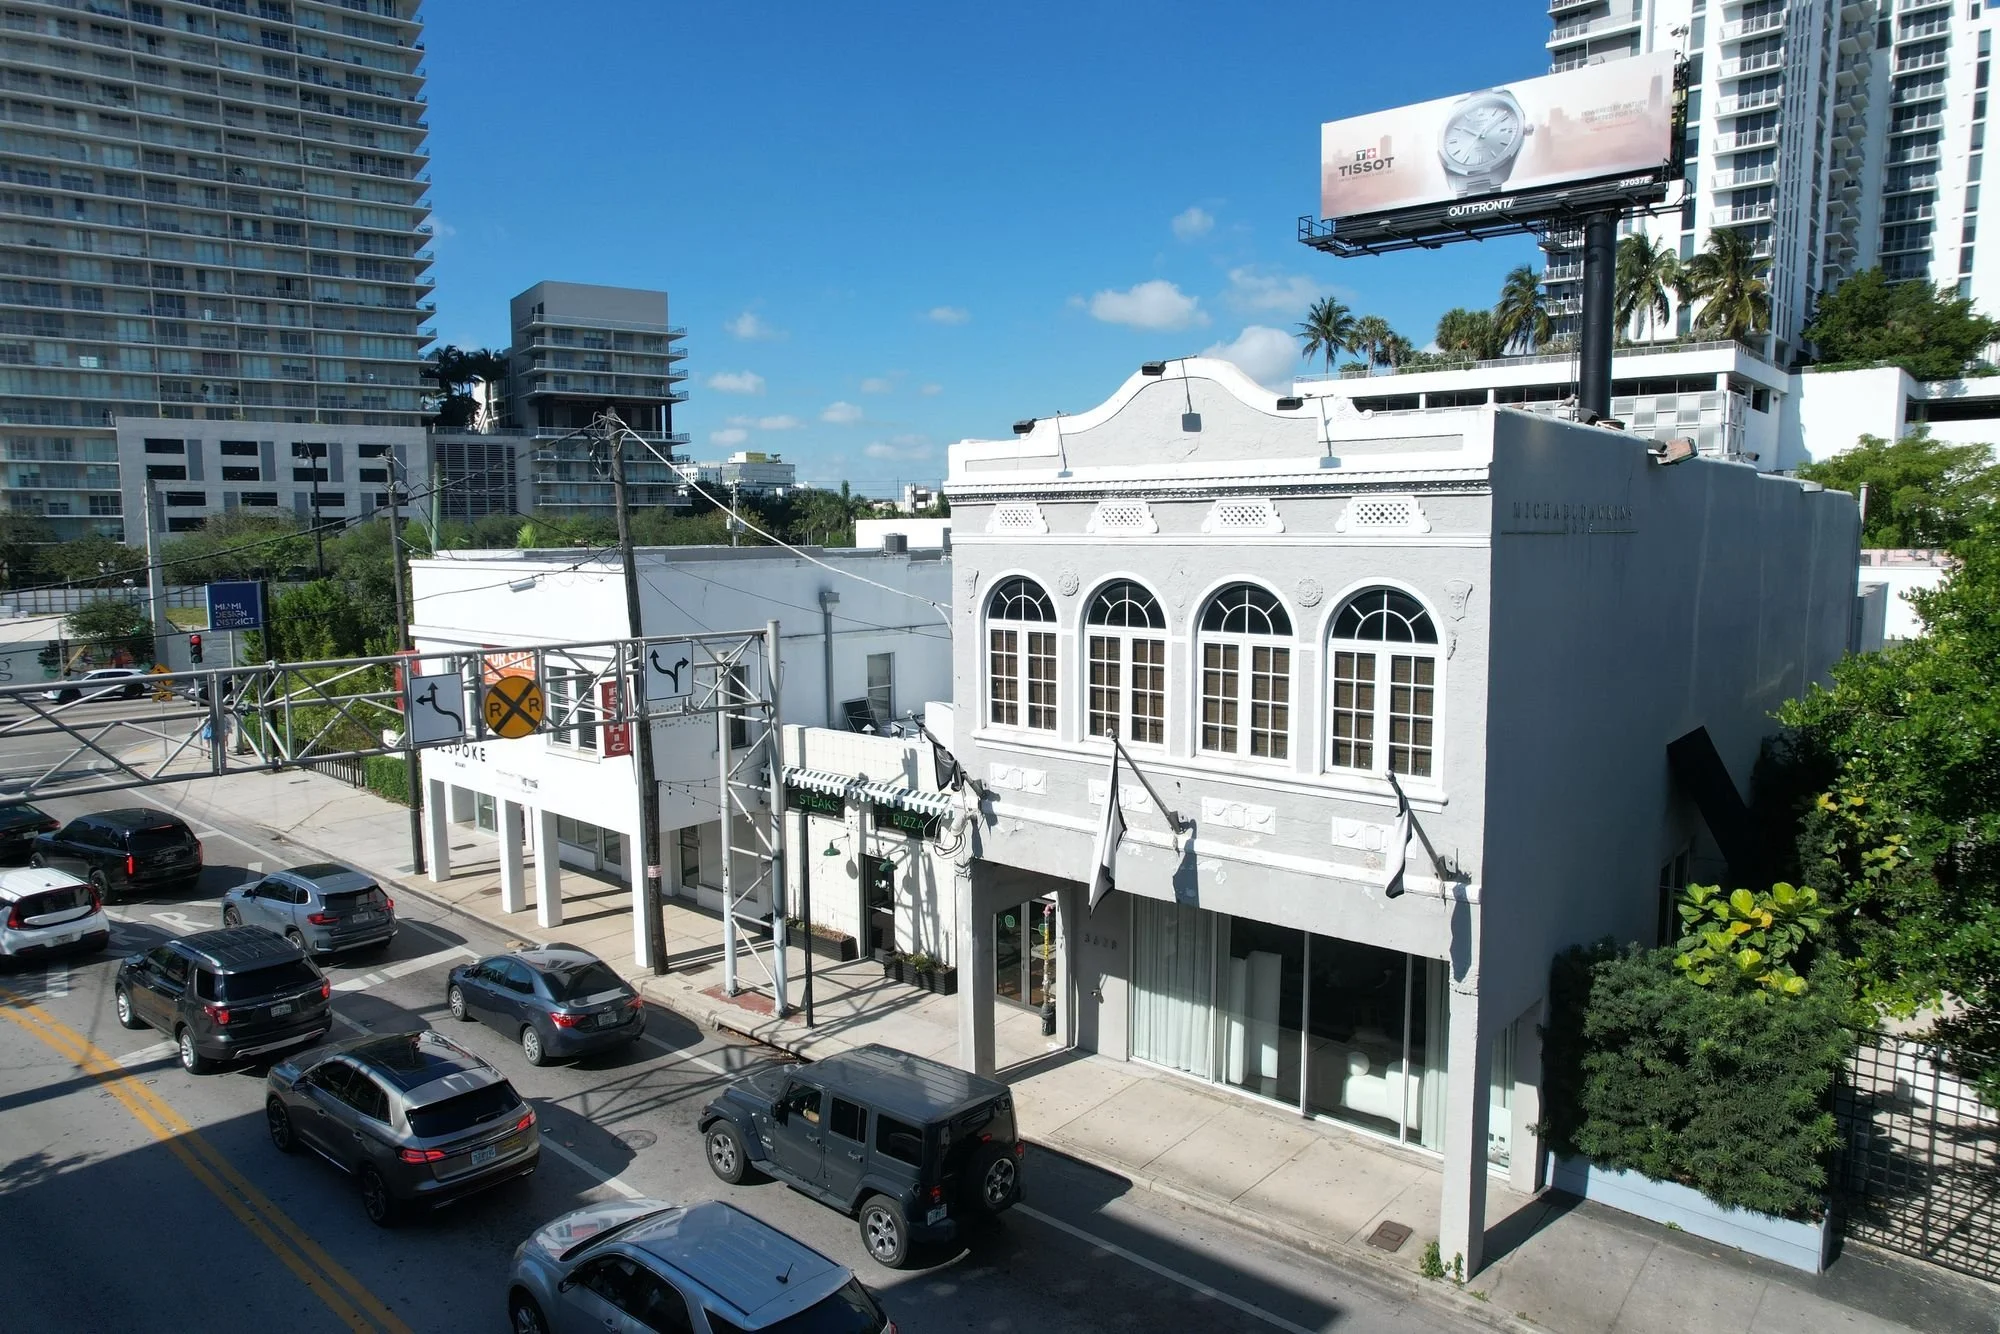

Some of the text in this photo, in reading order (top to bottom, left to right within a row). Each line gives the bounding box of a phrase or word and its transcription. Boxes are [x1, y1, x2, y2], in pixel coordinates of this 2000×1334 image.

[1338, 156, 1394, 177] TISSOT
[215, 602, 241, 610] MIAMI
[216, 618, 254, 627] DISTRICT
[434, 744, 486, 762] ESPOKE
[799, 795, 838, 812] STEAKS
[892, 814, 924, 830] PIZZA
